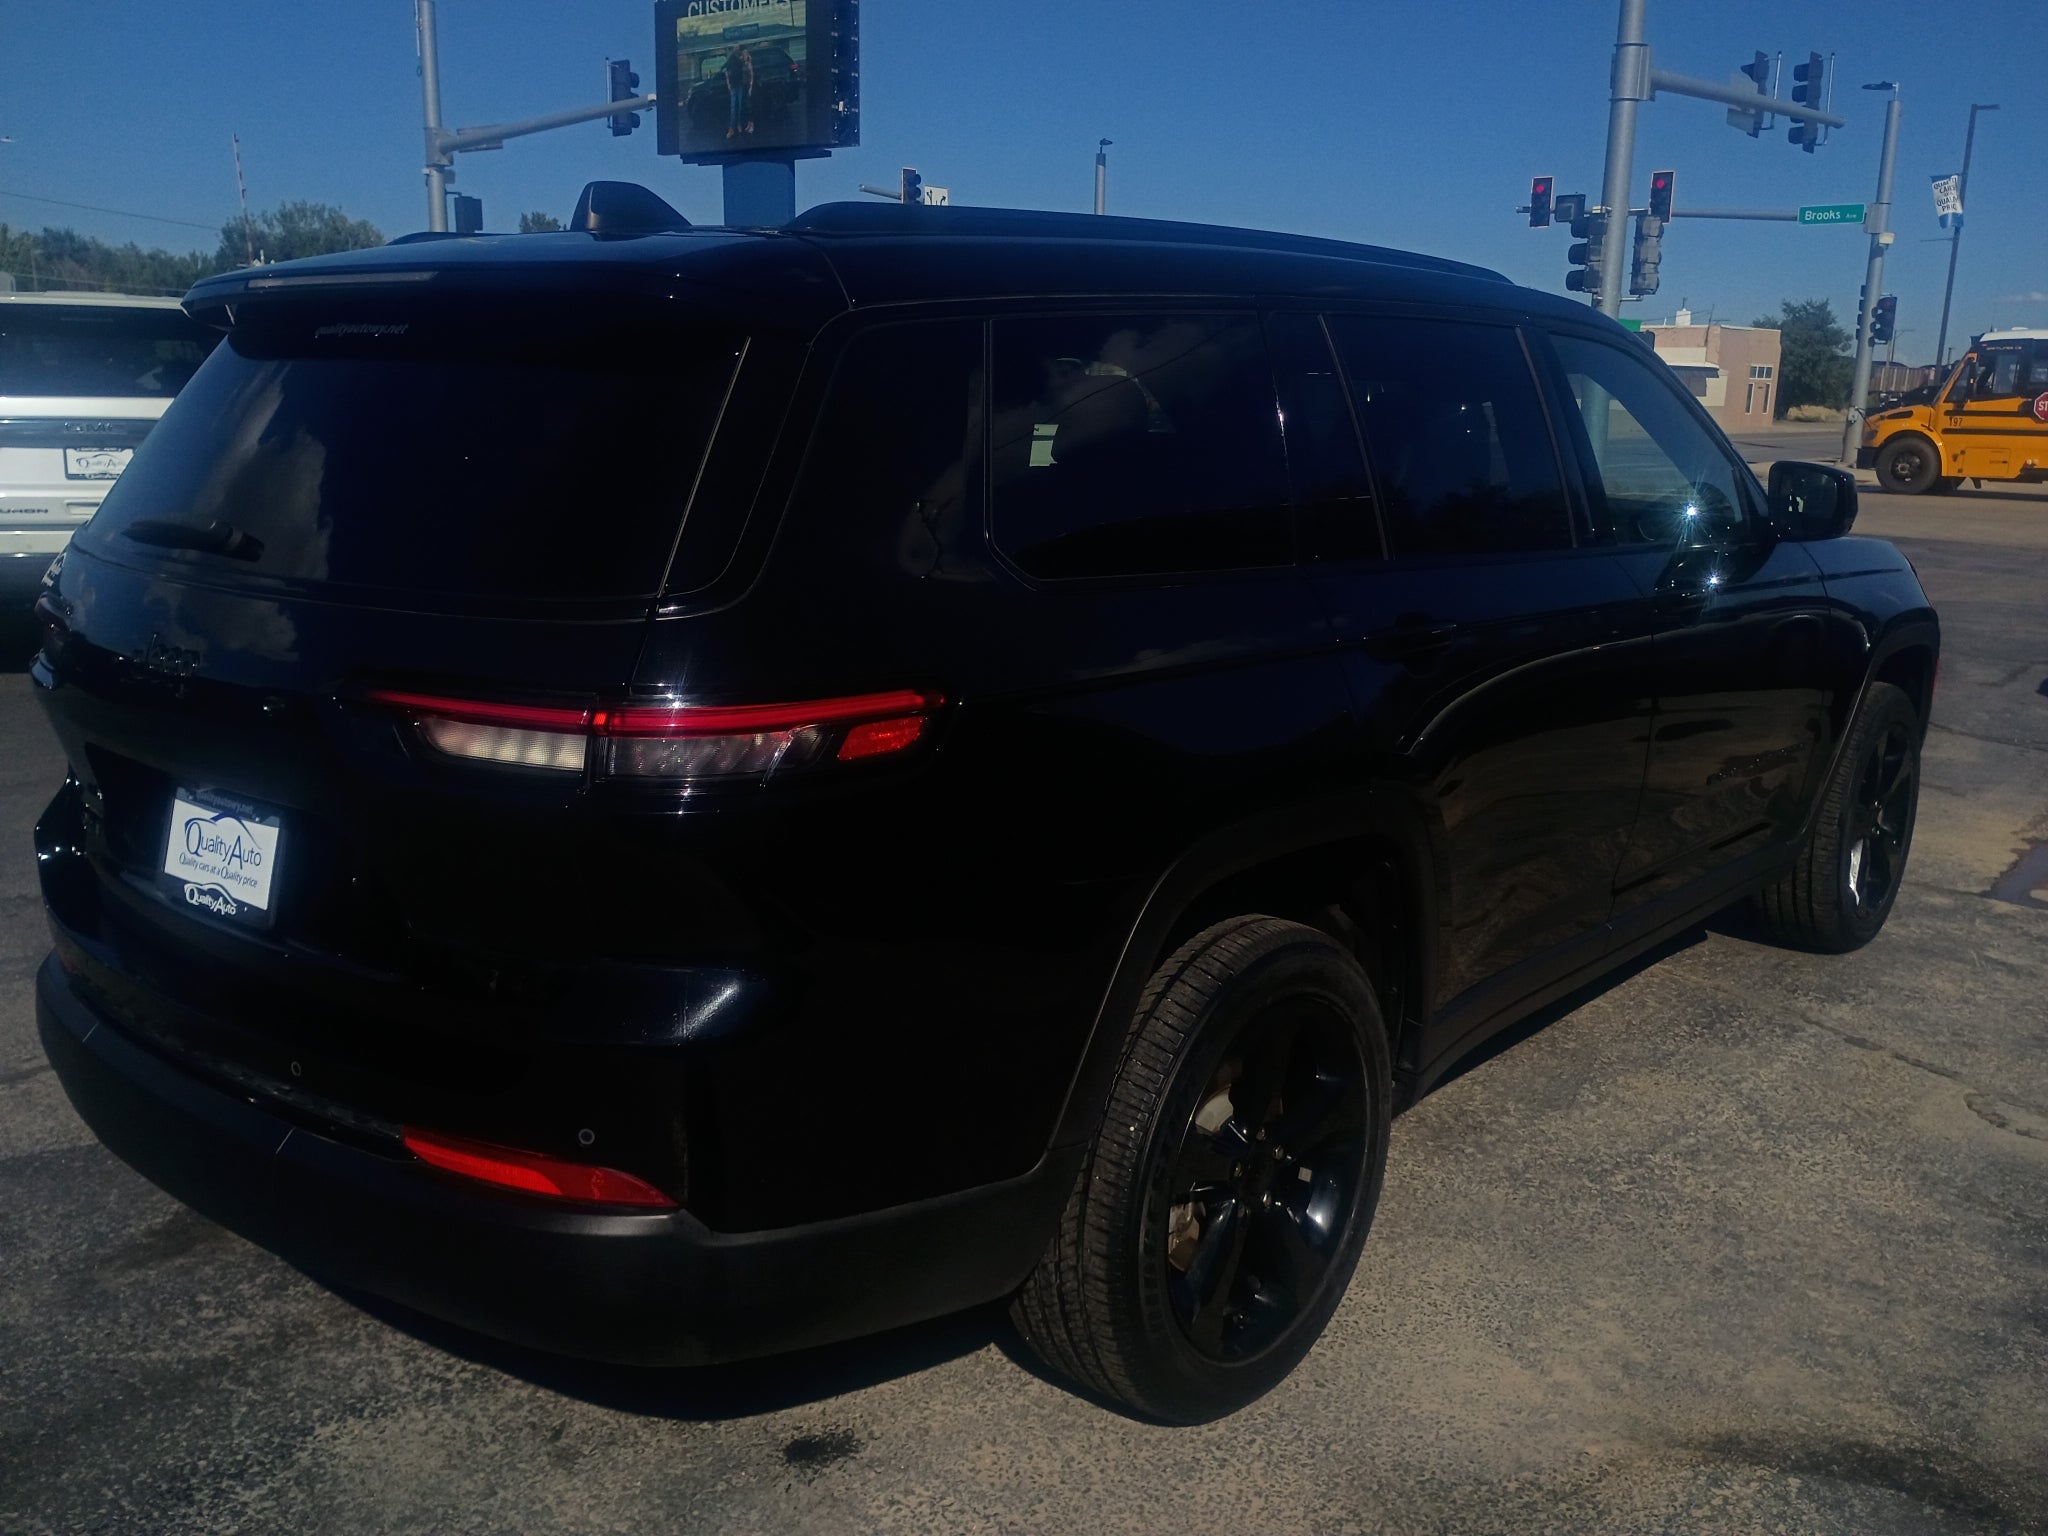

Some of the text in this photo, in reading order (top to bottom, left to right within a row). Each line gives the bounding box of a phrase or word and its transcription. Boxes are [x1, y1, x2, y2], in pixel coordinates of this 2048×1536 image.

[688, 0, 791, 17] CUSTOMES
[1805, 210, 1841, 220] Brooks
[1949, 416, 1963, 427] 197
[179, 852, 199, 869] Quality
[198, 861, 210, 872] cars
[220, 866, 242, 885] Quality
[242, 875, 258, 888] price
